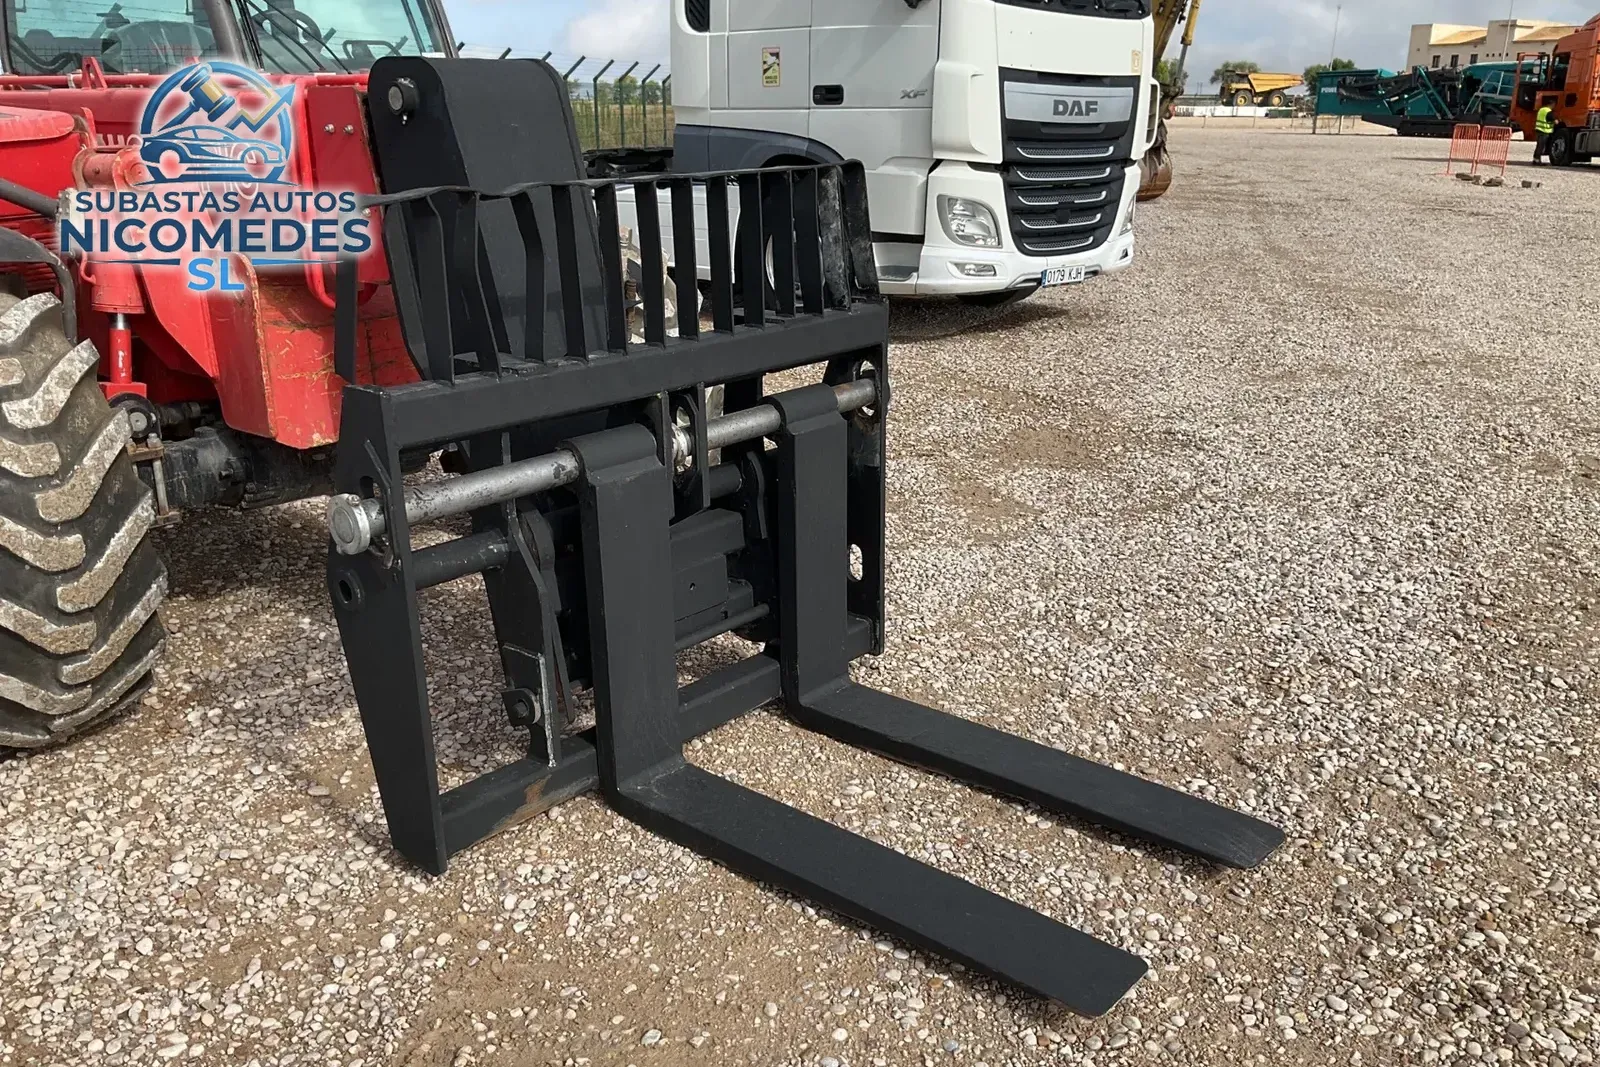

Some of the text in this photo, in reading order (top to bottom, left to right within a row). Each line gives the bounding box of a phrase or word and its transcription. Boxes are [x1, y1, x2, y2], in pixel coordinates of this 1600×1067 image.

[899, 89, 928, 100] XF
[1052, 99, 1098, 117] DAF
[1047, 267, 1083, 282] 0179 KJH
